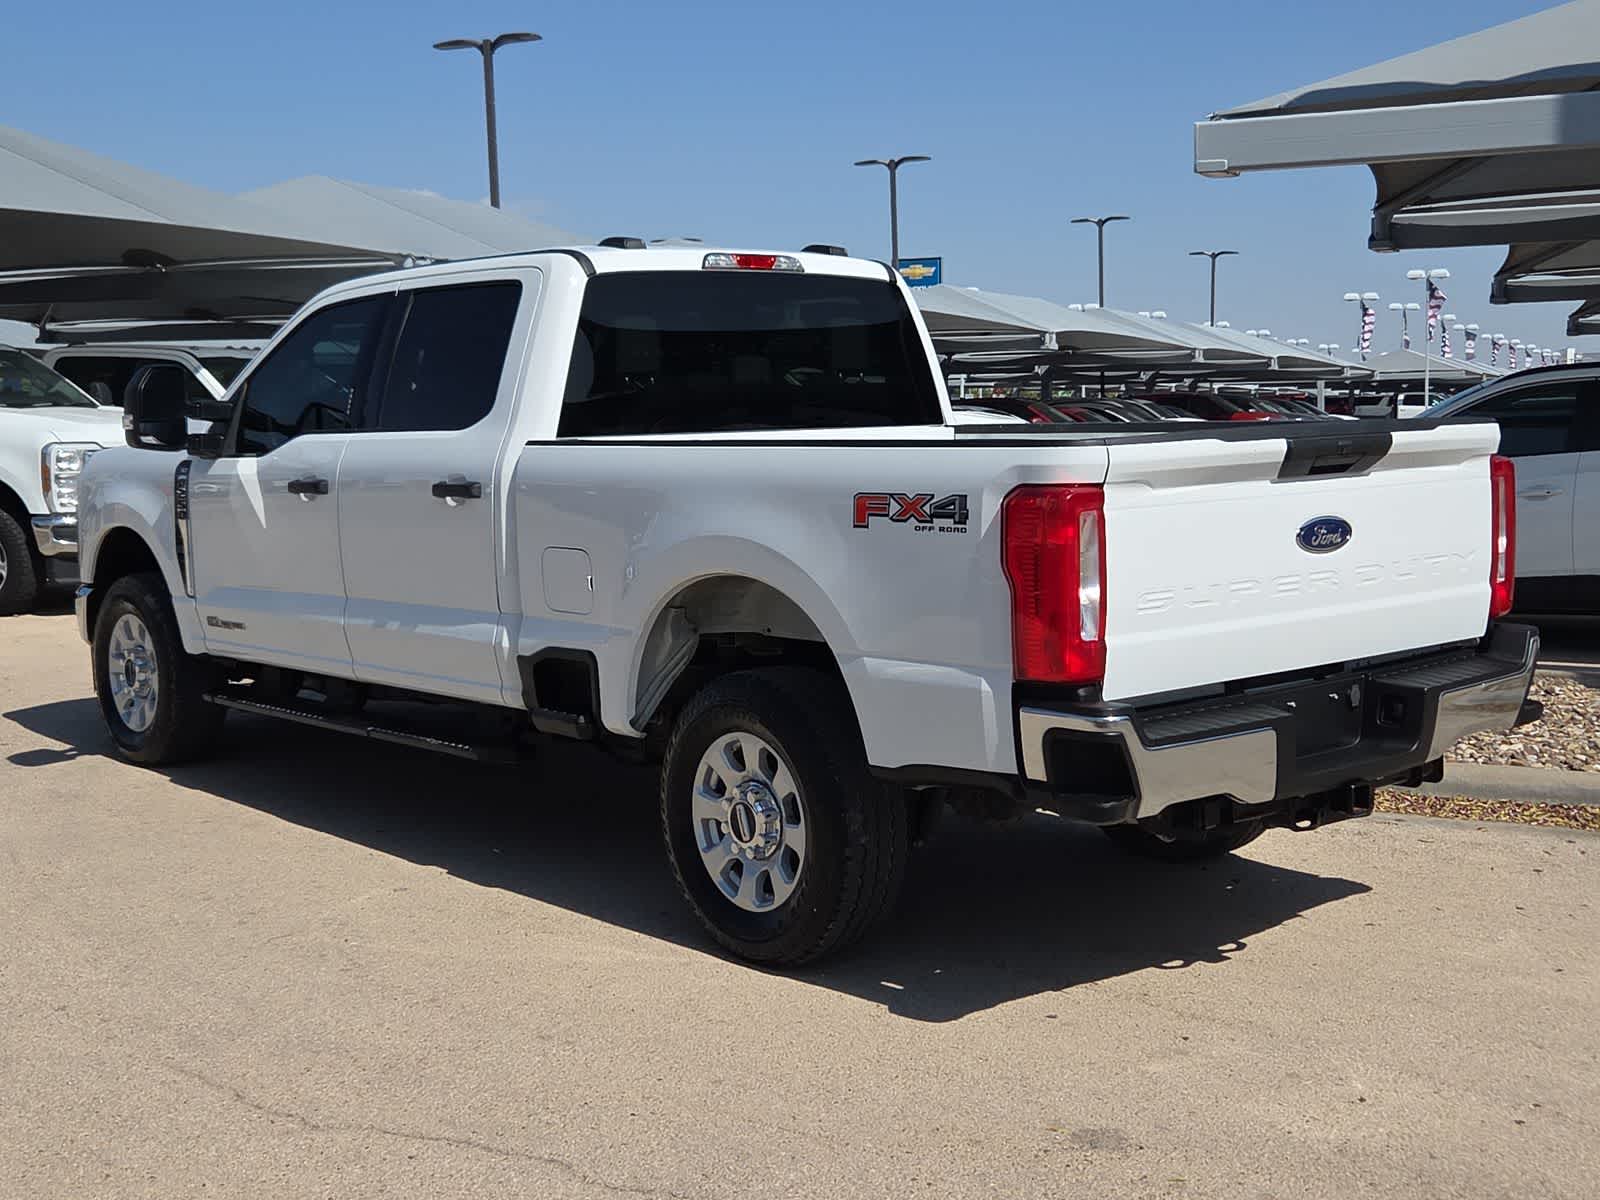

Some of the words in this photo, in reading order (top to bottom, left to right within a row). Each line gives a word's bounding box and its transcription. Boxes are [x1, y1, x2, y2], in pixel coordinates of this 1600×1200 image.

[853, 492, 969, 528] FX4
[938, 526, 967, 534] ROAD
[1311, 525, 1342, 546] Ford
[1136, 568, 1342, 615] SUPER
[1352, 547, 1479, 586] DUTY
